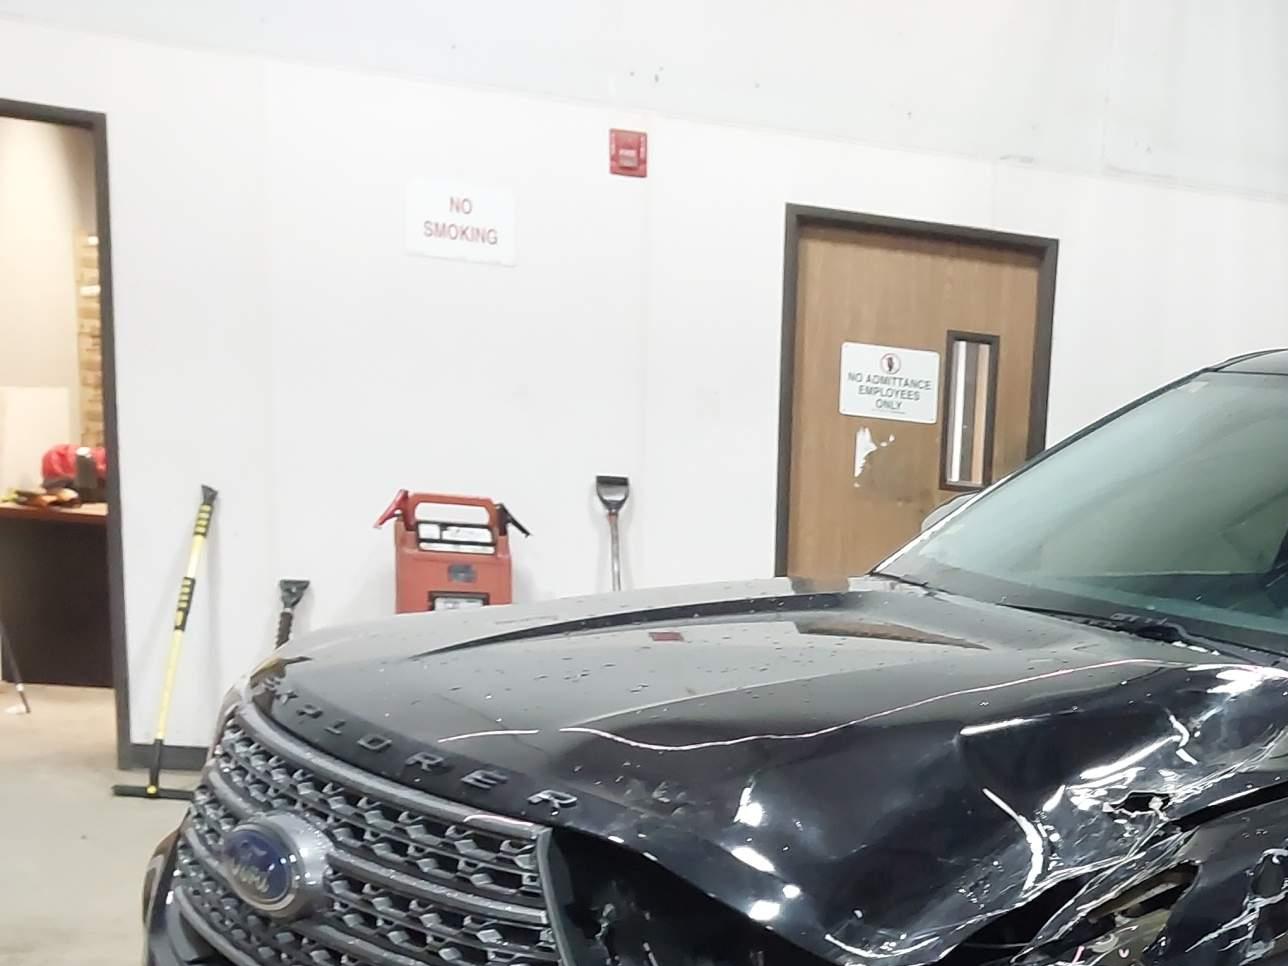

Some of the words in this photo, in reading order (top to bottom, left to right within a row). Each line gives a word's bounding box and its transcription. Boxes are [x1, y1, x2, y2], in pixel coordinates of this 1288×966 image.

[449, 197, 473, 215] NO
[423, 220, 498, 245] SMOKING
[848, 372, 863, 383] NO
[865, 374, 932, 390] ADMITTANCE
[858, 385, 920, 401] EMPLOYEES
[875, 398, 902, 410] ONLY
